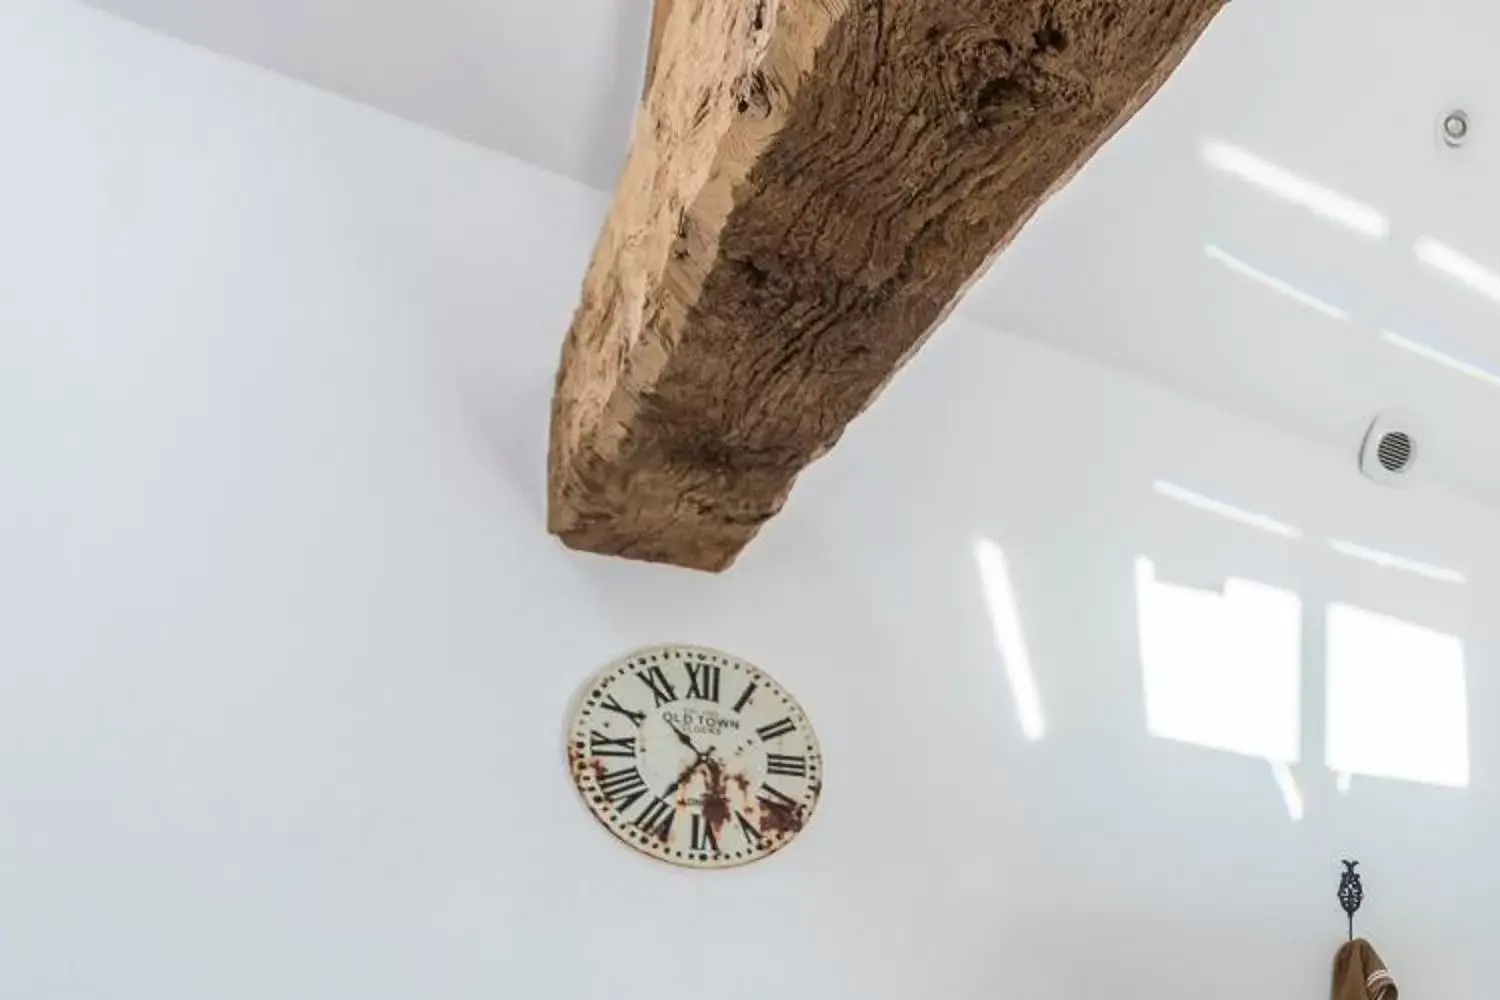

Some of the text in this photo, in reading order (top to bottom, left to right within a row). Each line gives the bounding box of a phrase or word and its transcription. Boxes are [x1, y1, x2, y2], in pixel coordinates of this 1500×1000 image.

[637, 665, 679, 708] XI
[684, 661, 720, 704] XII
[600, 693, 646, 728] X
[662, 710, 693, 725] OLD
[698, 715, 740, 730] TOWN
[757, 717, 797, 742] II
[590, 730, 637, 758] IX
[766, 752, 806, 778] III
